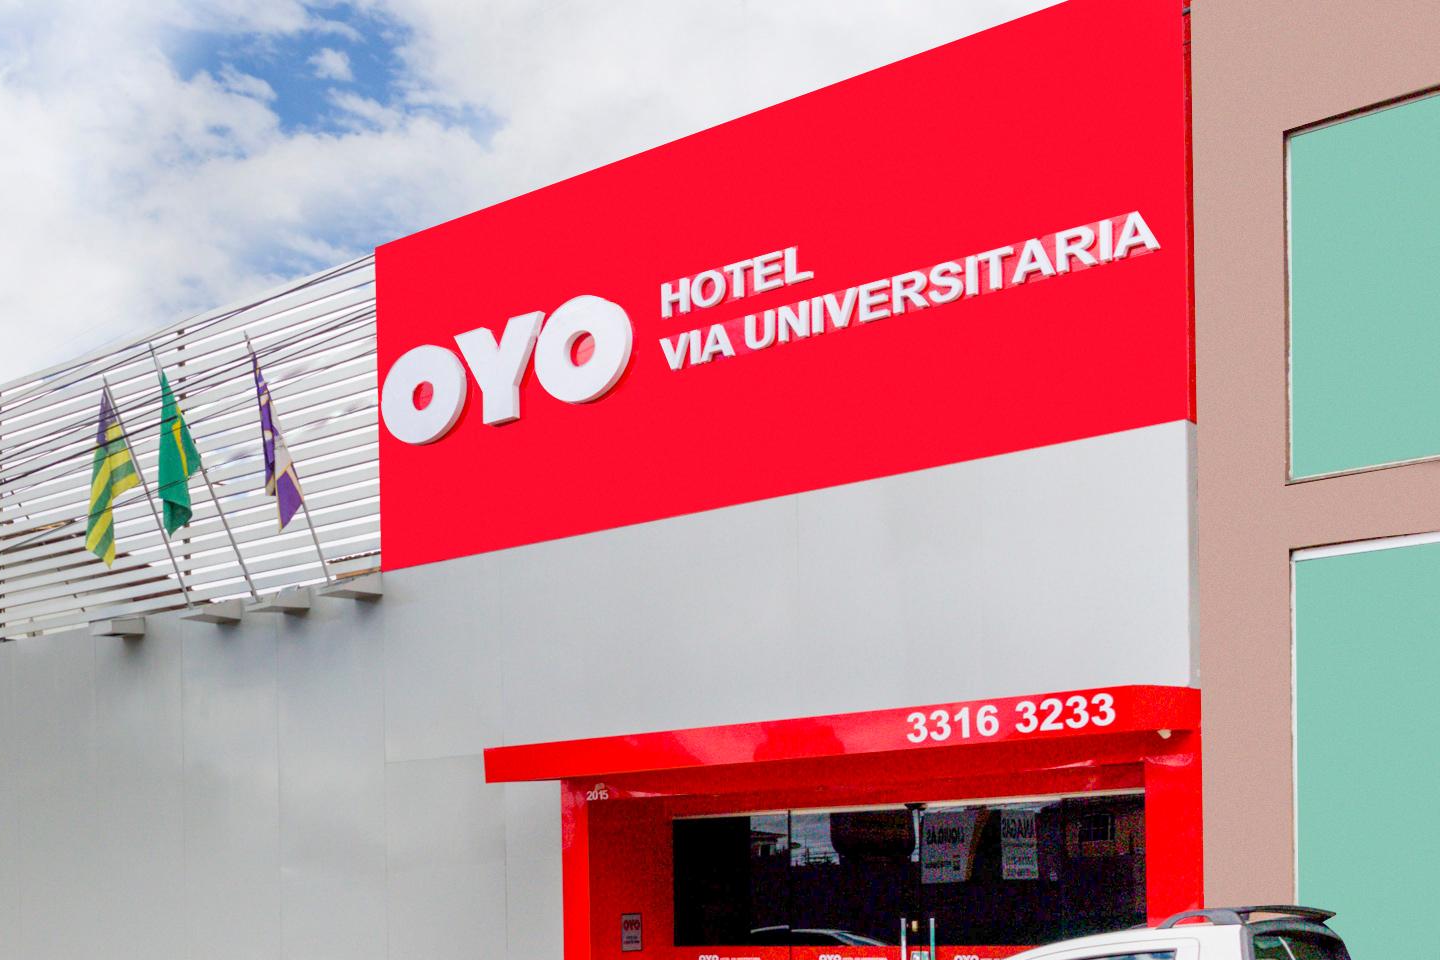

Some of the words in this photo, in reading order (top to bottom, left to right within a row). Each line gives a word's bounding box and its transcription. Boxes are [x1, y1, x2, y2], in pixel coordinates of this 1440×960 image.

[659, 323, 736, 371] VIA
[744, 210, 1162, 351] UNIVERSITARIA
[660, 246, 815, 319] HOTEL
[381, 294, 634, 446] OYO
[906, 704, 1000, 743] 3316
[1014, 692, 1117, 734] 3233
[586, 790, 609, 801] 2015
[623, 919, 641, 931] OYO
